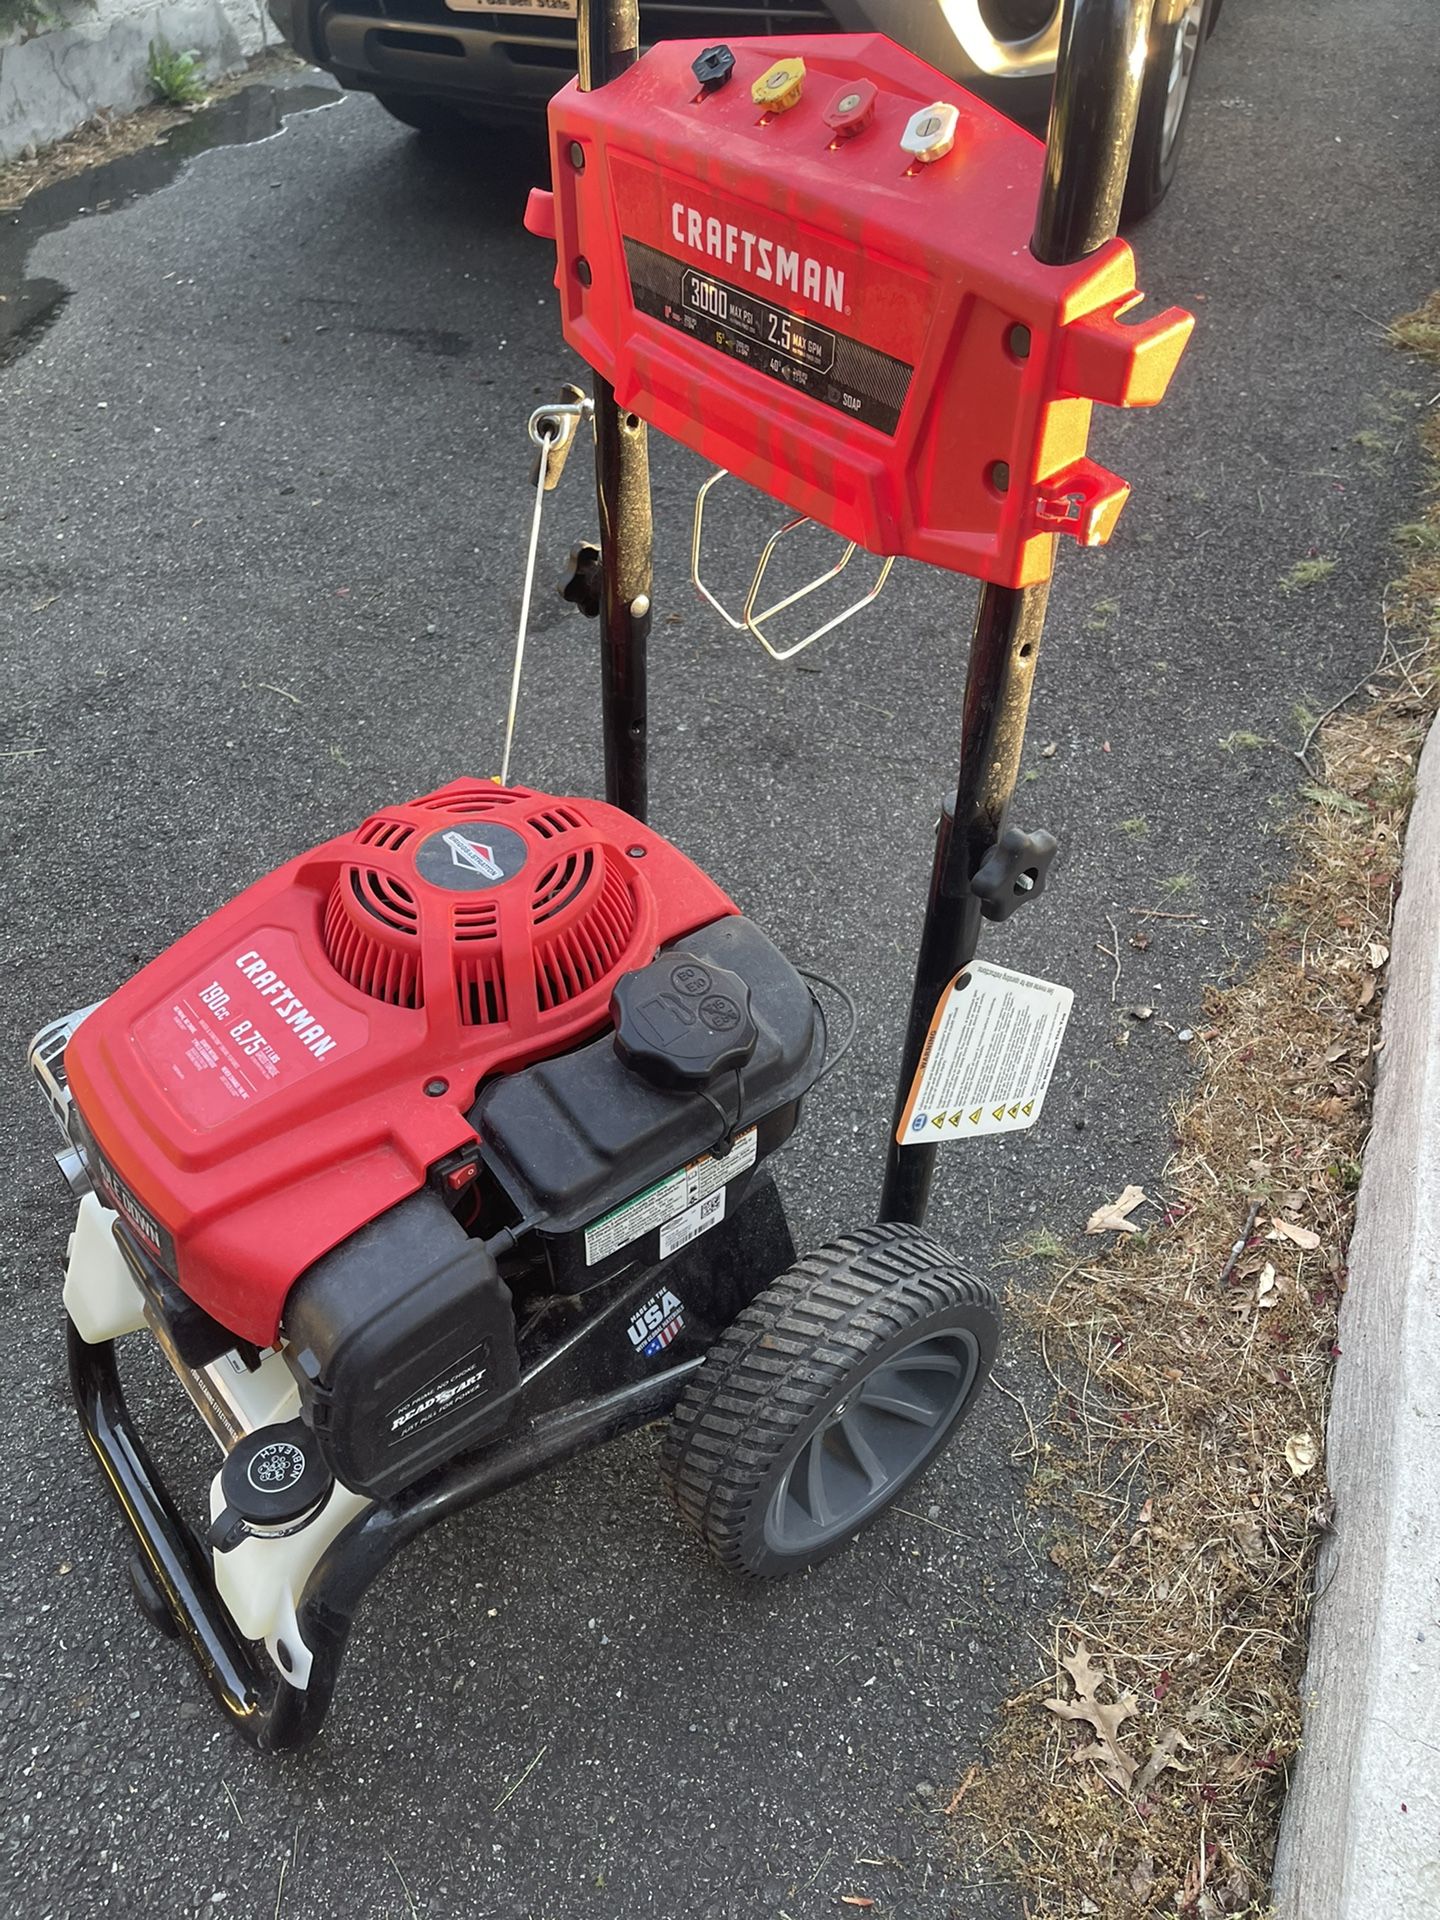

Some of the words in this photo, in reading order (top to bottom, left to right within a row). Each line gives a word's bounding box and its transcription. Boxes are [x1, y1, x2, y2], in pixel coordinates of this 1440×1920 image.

[672, 202, 845, 313] CRAFTSMAN
[691, 277, 727, 320] 3000
[729, 303, 742, 318] MAX
[768, 313, 791, 350] 2.5
[792, 333, 806, 350] MAX
[842, 393, 862, 411] SOAP
[198, 981, 230, 1021] 190cc
[235, 950, 338, 1058] CRAFTSMAN
[229, 1020, 268, 1056] 8.75
[920, 1030, 937, 1070] WARNING
[122, 1191, 161, 1249] DOWN
[627, 1291, 682, 1346] USA
[630, 1304, 648, 1323] MADE
[655, 1286, 667, 1299] THE
[260, 1445, 302, 1463] BLEACH
[290, 1463, 302, 1479] NO
